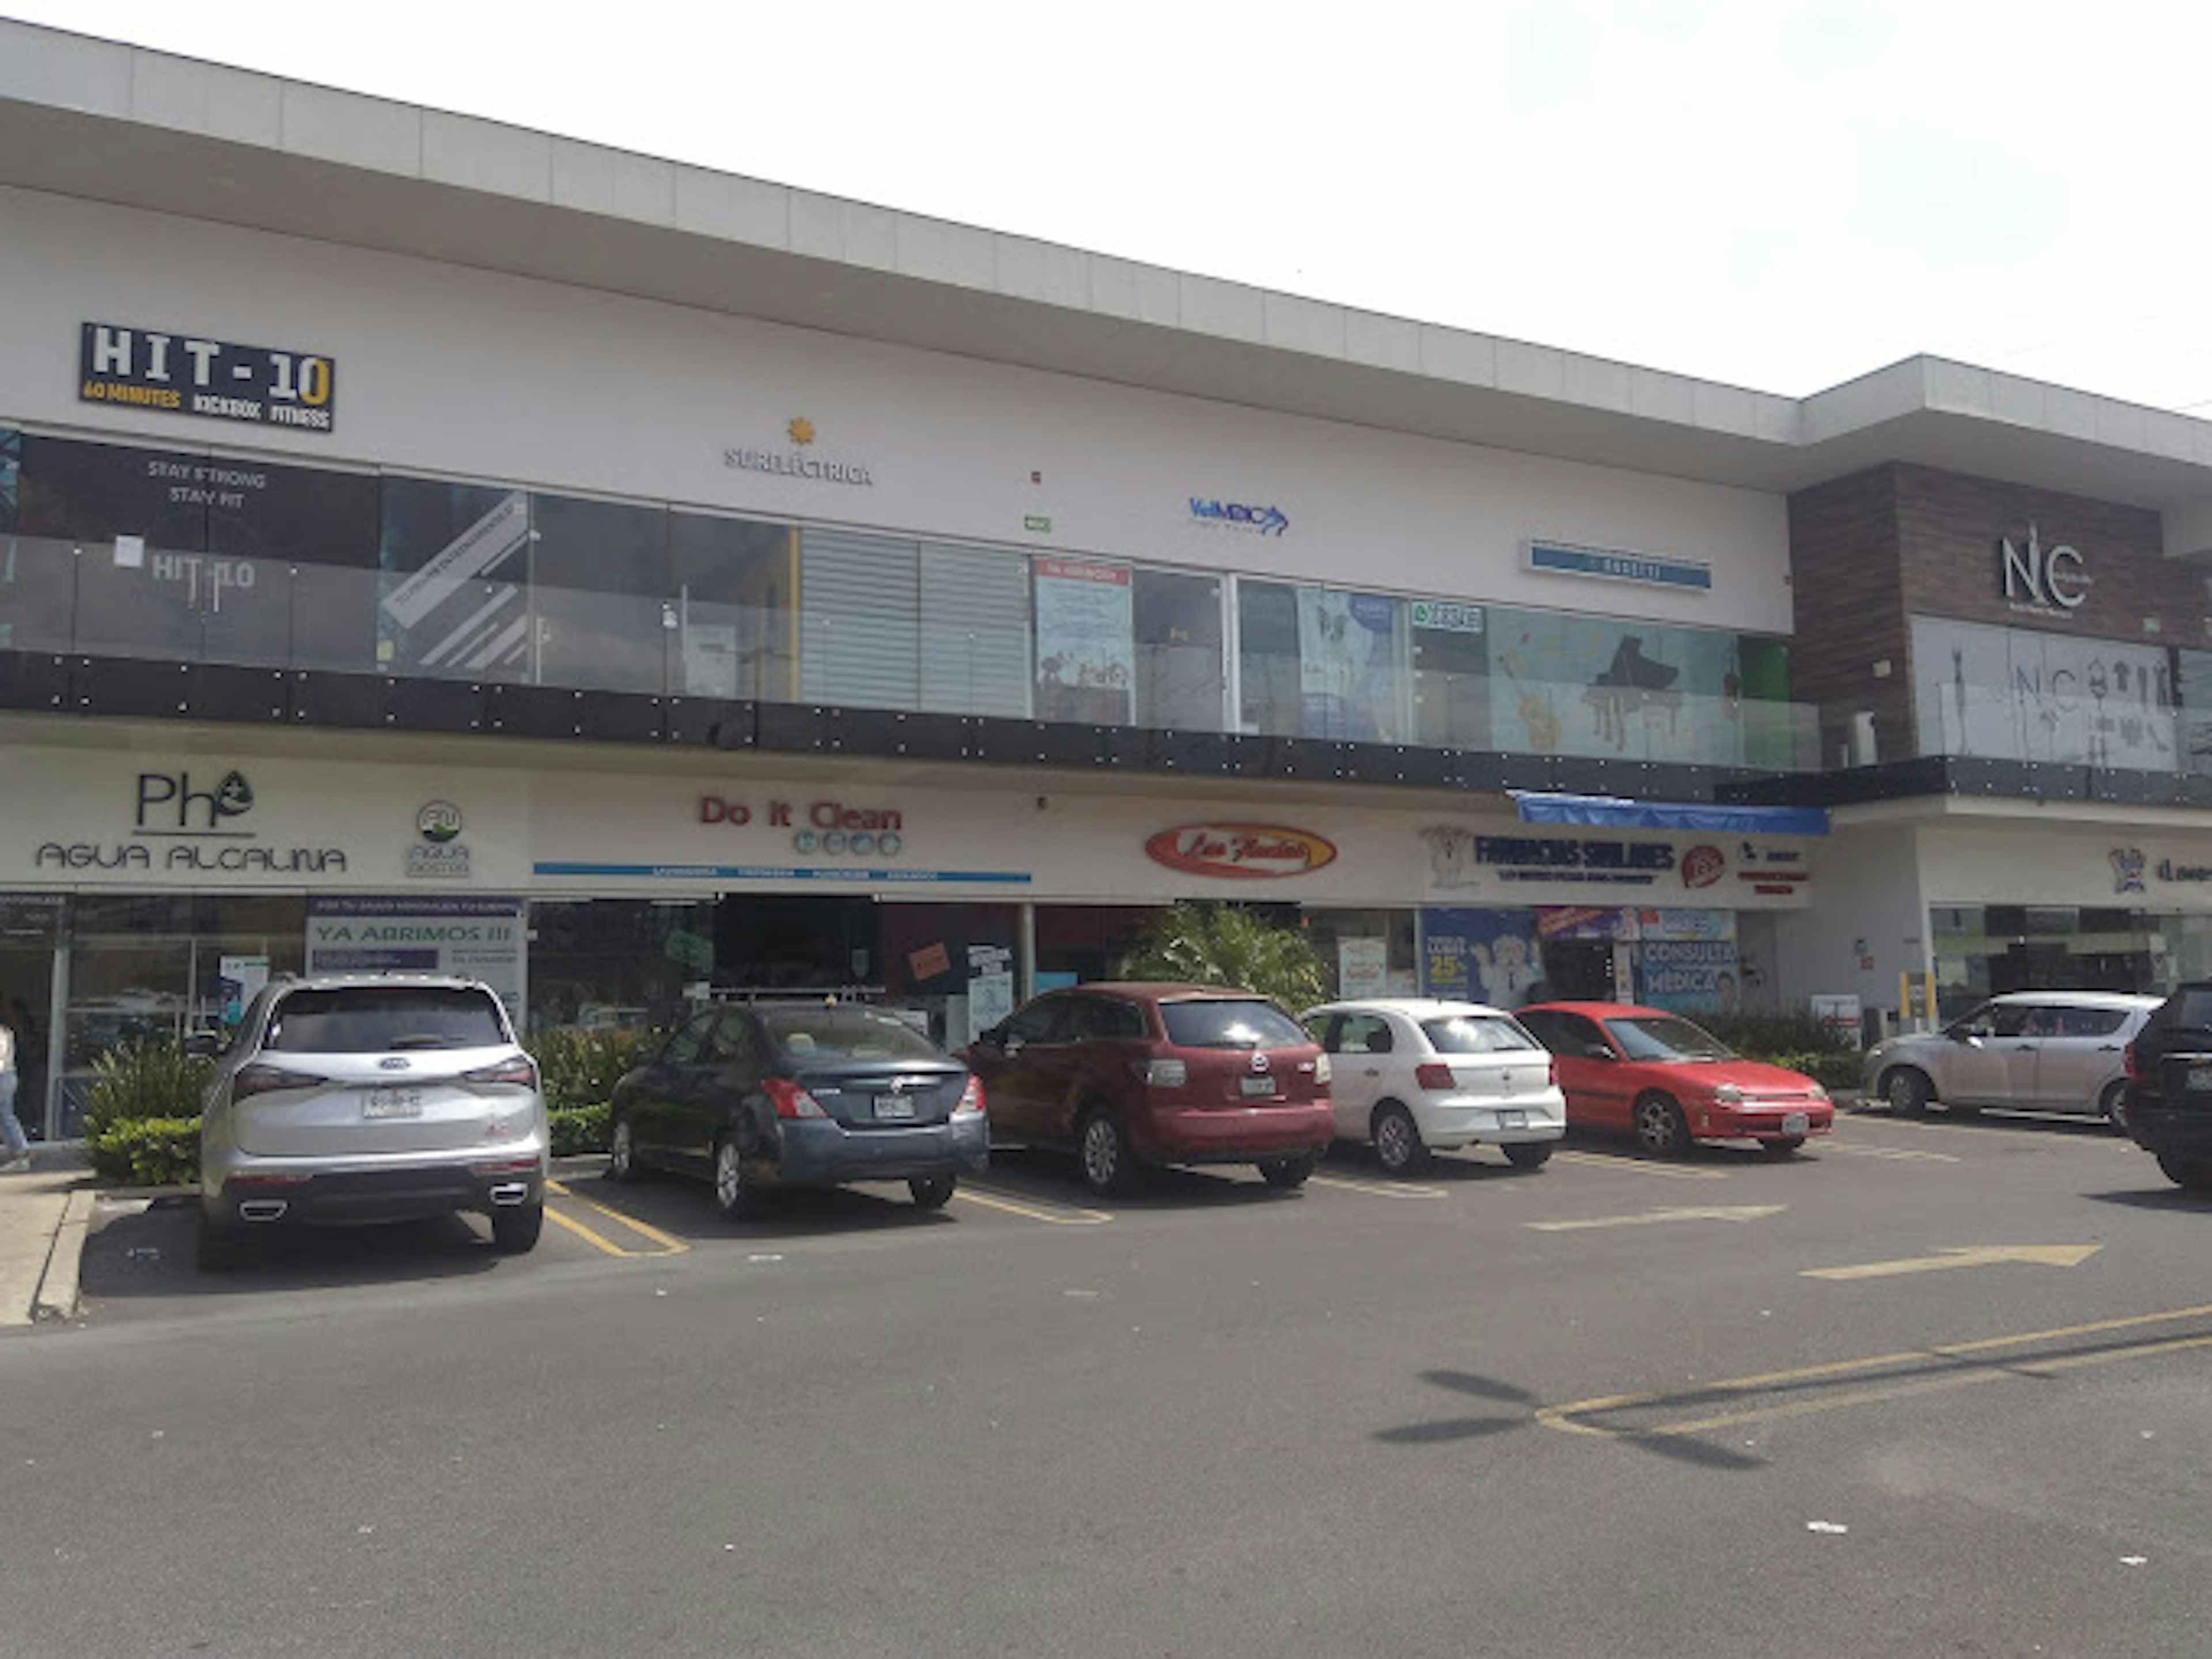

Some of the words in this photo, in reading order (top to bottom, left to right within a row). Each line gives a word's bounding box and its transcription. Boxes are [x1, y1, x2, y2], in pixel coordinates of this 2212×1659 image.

[108, 385, 181, 408] MINUTES
[270, 406, 330, 429] FITNESS
[148, 461, 190, 478] STAY
[195, 467, 265, 488] STRONG
[169, 487, 216, 505] STAY
[701, 797, 751, 825] Do
[809, 802, 902, 830] Clean
[35, 842, 150, 869] AGUA
[166, 844, 346, 873] ALCALINA
[317, 926, 352, 941] YA
[361, 926, 482, 941] ABRIMOS
